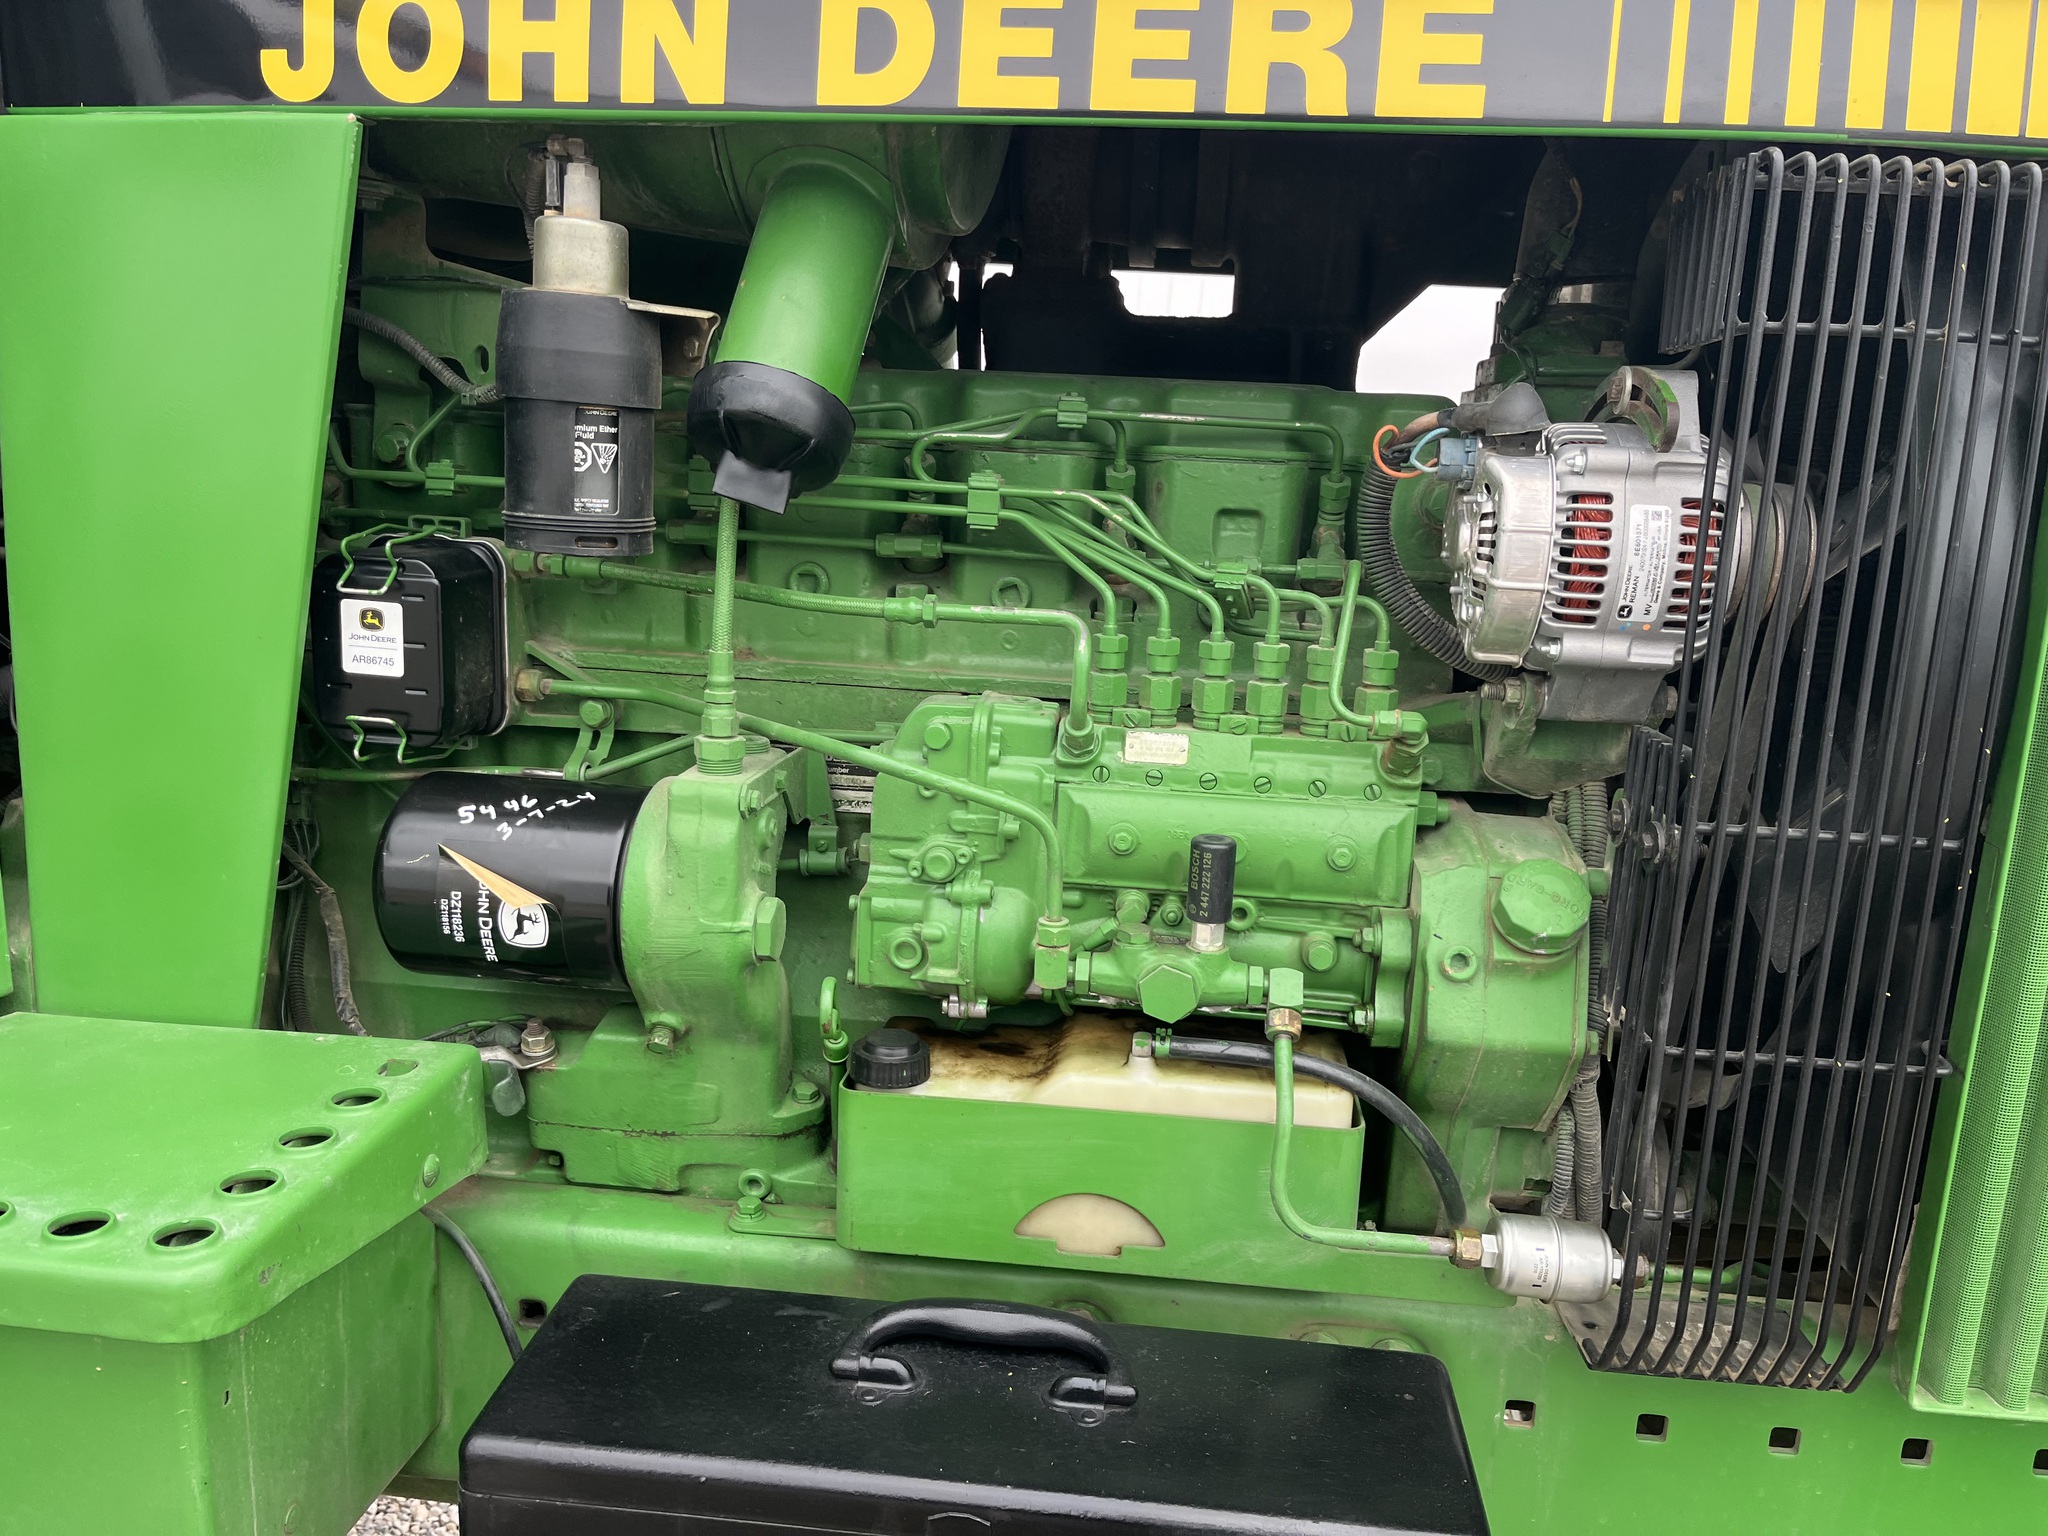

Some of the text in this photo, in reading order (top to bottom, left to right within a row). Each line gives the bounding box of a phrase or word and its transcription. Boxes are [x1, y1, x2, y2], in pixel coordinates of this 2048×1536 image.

[260, 0, 1496, 120] JOHN DEERE
[574, 423, 618, 433] mium Ether
[1621, 585, 1630, 603] JOHN
[1629, 576, 1640, 603] REMAN
[1644, 603, 1653, 616] MV
[348, 633, 397, 644] JOHN DEERE
[352, 654, 395, 667] AR86745
[1190, 848, 1201, 891] BOSCH
[1199, 852, 1212, 918] 2 447 222 126
[450, 890, 465, 943] DZ118236
[478, 881, 499, 963] OHN DEERE
